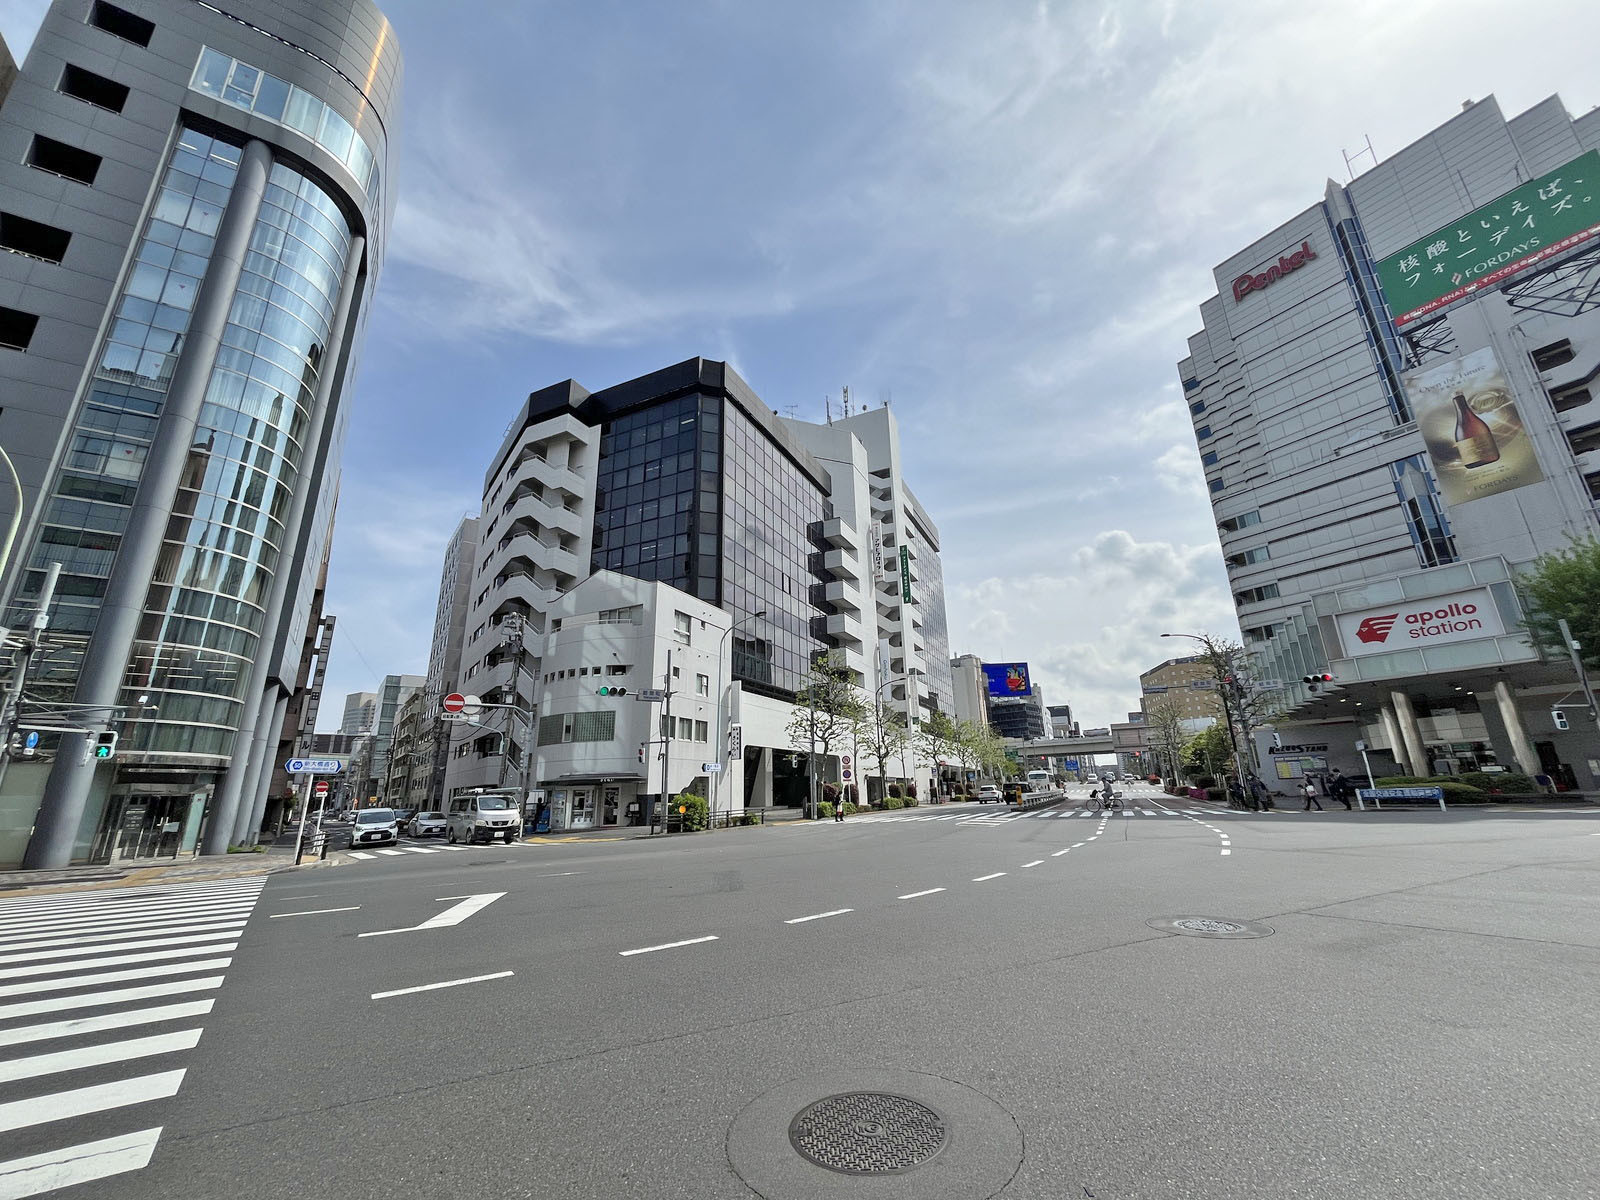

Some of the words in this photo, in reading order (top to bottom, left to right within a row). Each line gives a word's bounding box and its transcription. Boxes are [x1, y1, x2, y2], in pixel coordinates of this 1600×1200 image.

[1465, 236, 1540, 277] FORDAYS
[1232, 241, 1317, 304] Pentel
[1473, 475, 1519, 491] FORDAYS
[1405, 603, 1477, 626] apollo
[1409, 619, 1482, 639] station
